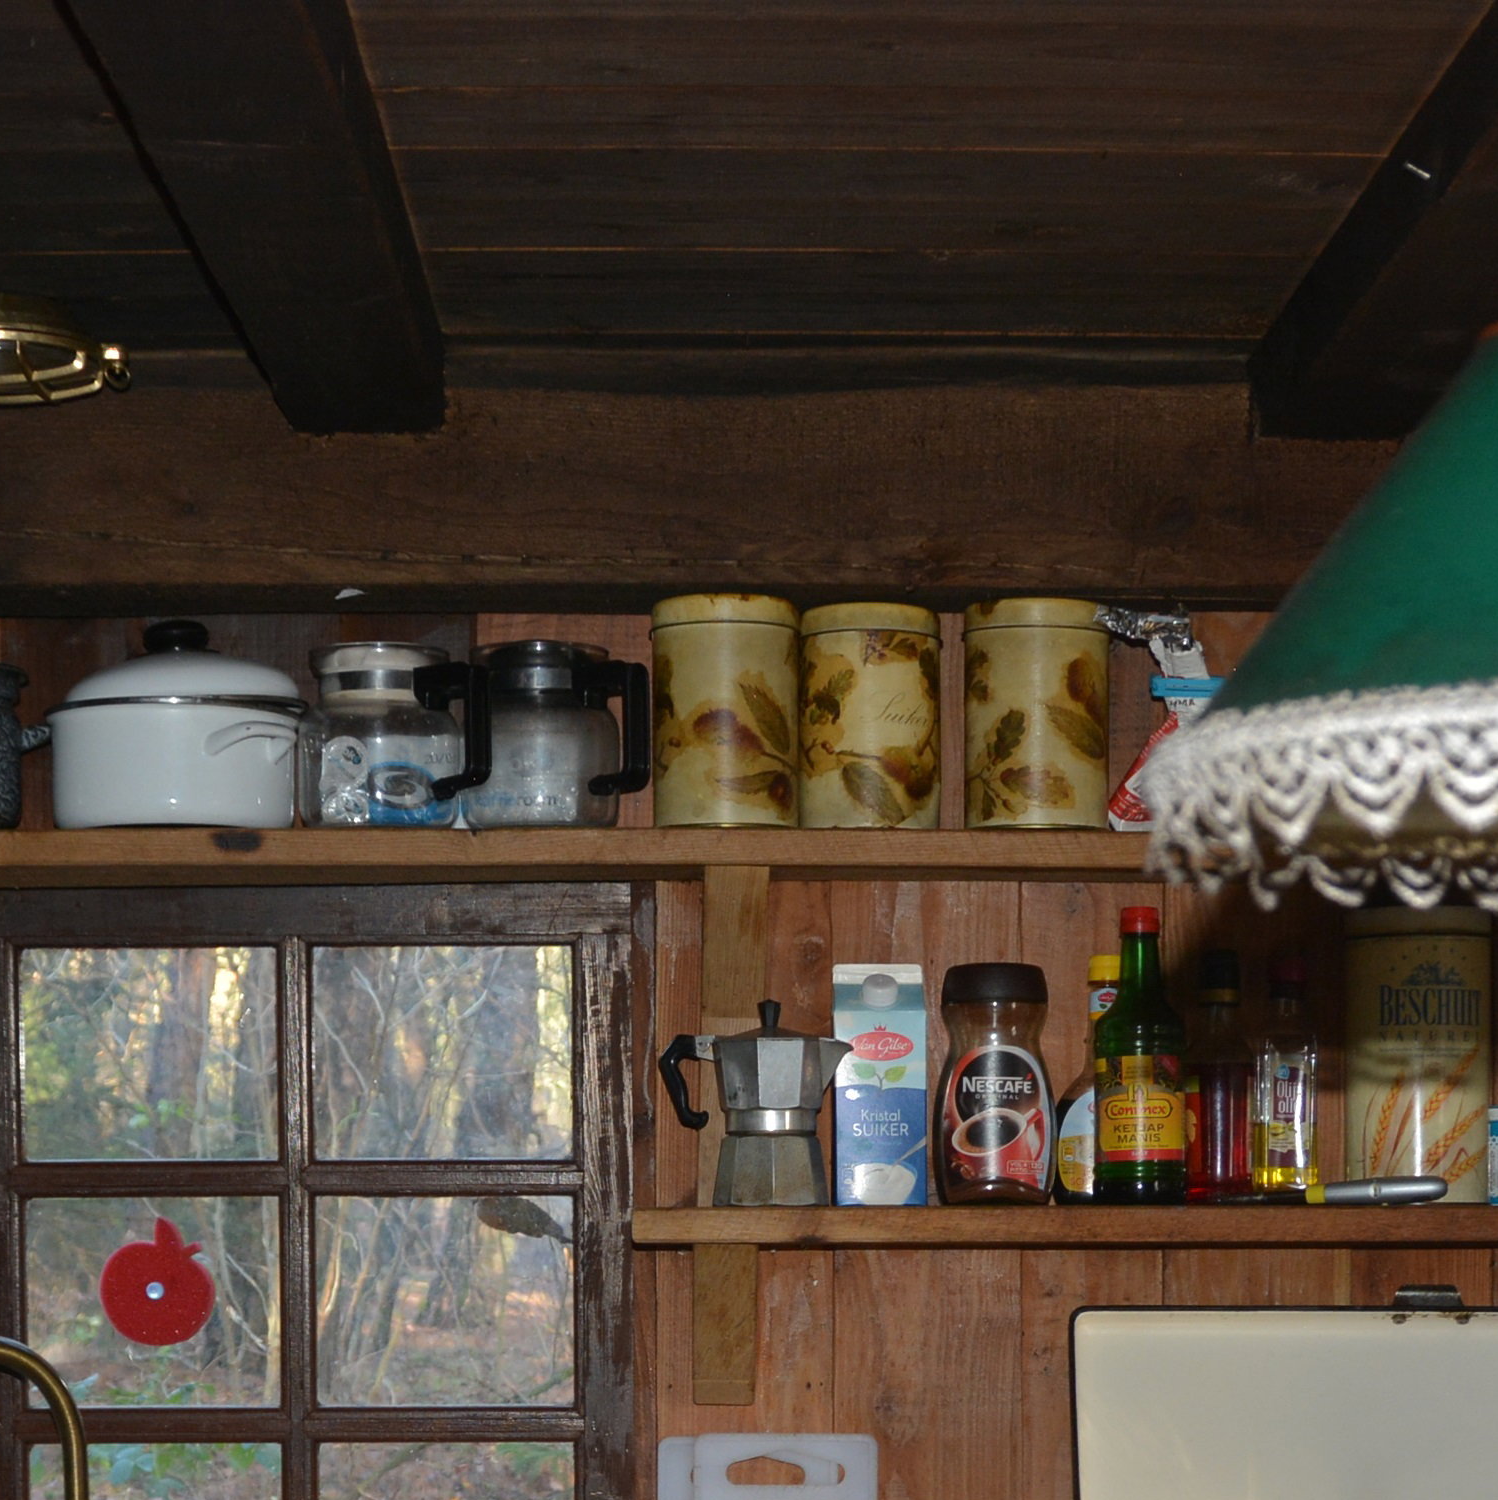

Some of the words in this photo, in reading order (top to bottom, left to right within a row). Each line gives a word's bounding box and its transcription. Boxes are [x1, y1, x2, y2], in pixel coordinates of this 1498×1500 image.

[878, 1036, 910, 1059] Gilse
[962, 1072, 1034, 1094] NESCAFÉ
[1276, 1080, 1299, 1100] Olij
[860, 1108, 902, 1122] Kristal
[852, 1122, 910, 1137] SUIKER
